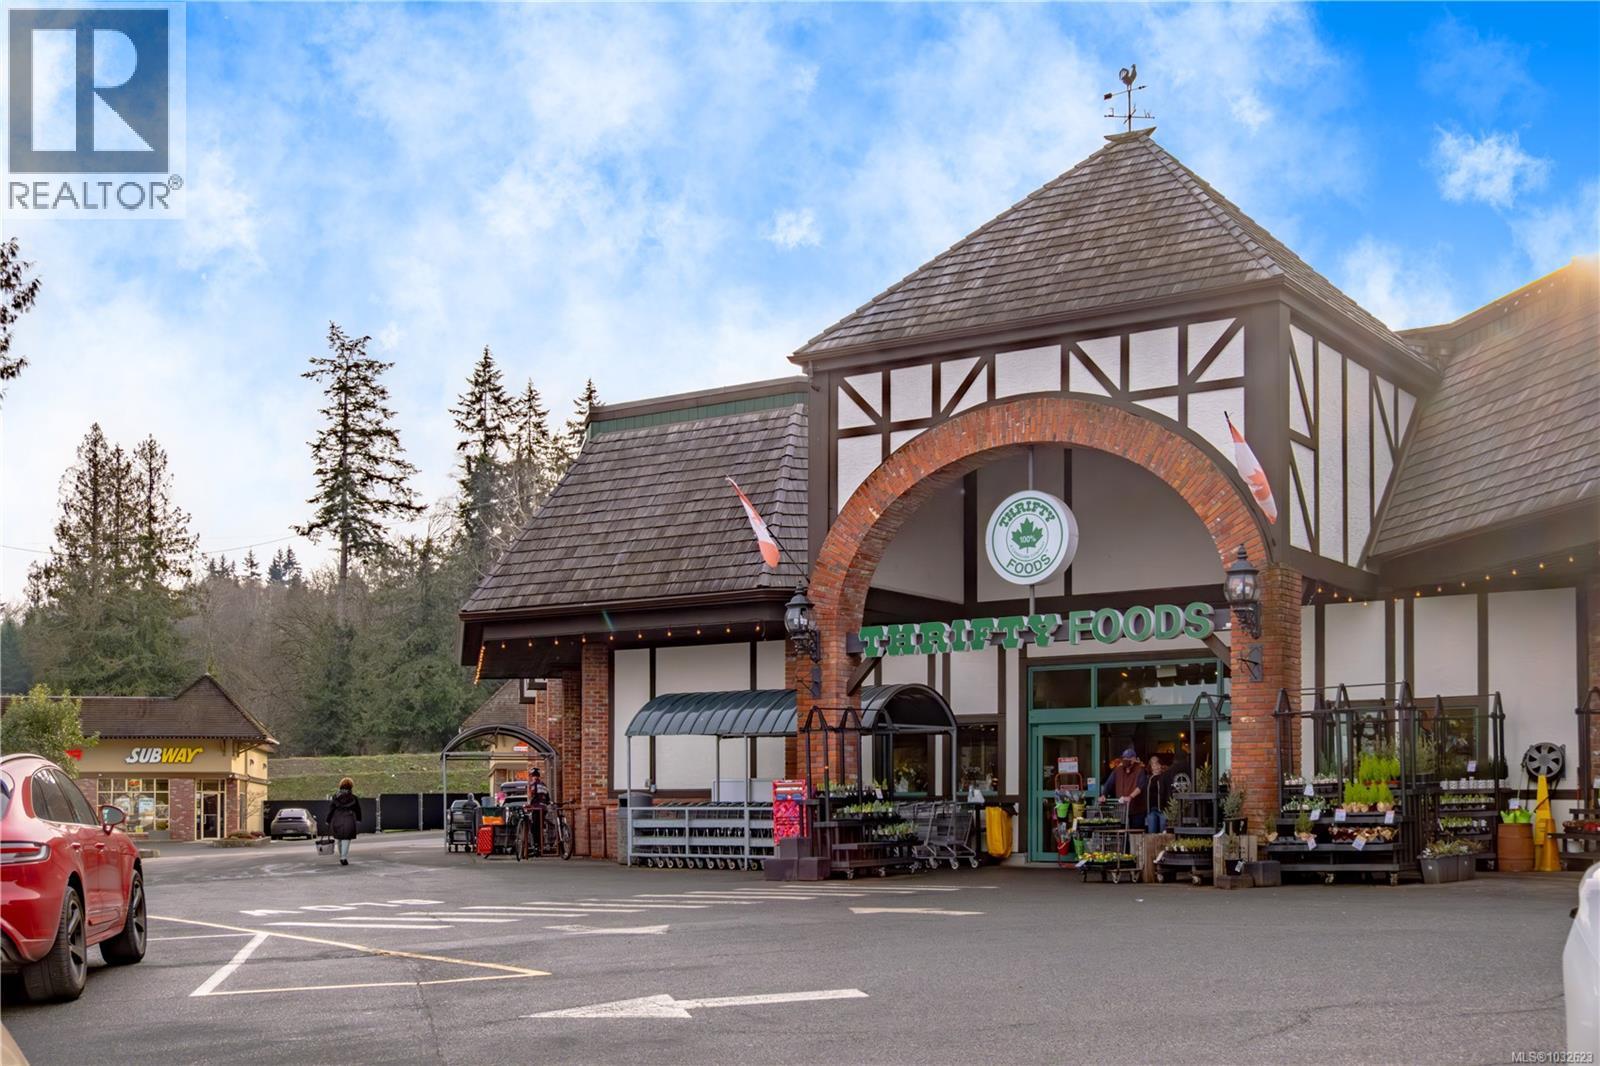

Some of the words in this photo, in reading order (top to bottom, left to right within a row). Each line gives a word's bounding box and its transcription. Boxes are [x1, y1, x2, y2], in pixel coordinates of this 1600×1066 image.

[999, 501, 1057, 528] THRIFTY
[1006, 553, 1051, 574] FOODS
[859, 613, 1062, 658] THRIFTY
[1069, 602, 1215, 645] FOODS
[125, 747, 204, 764] SUBWAY
